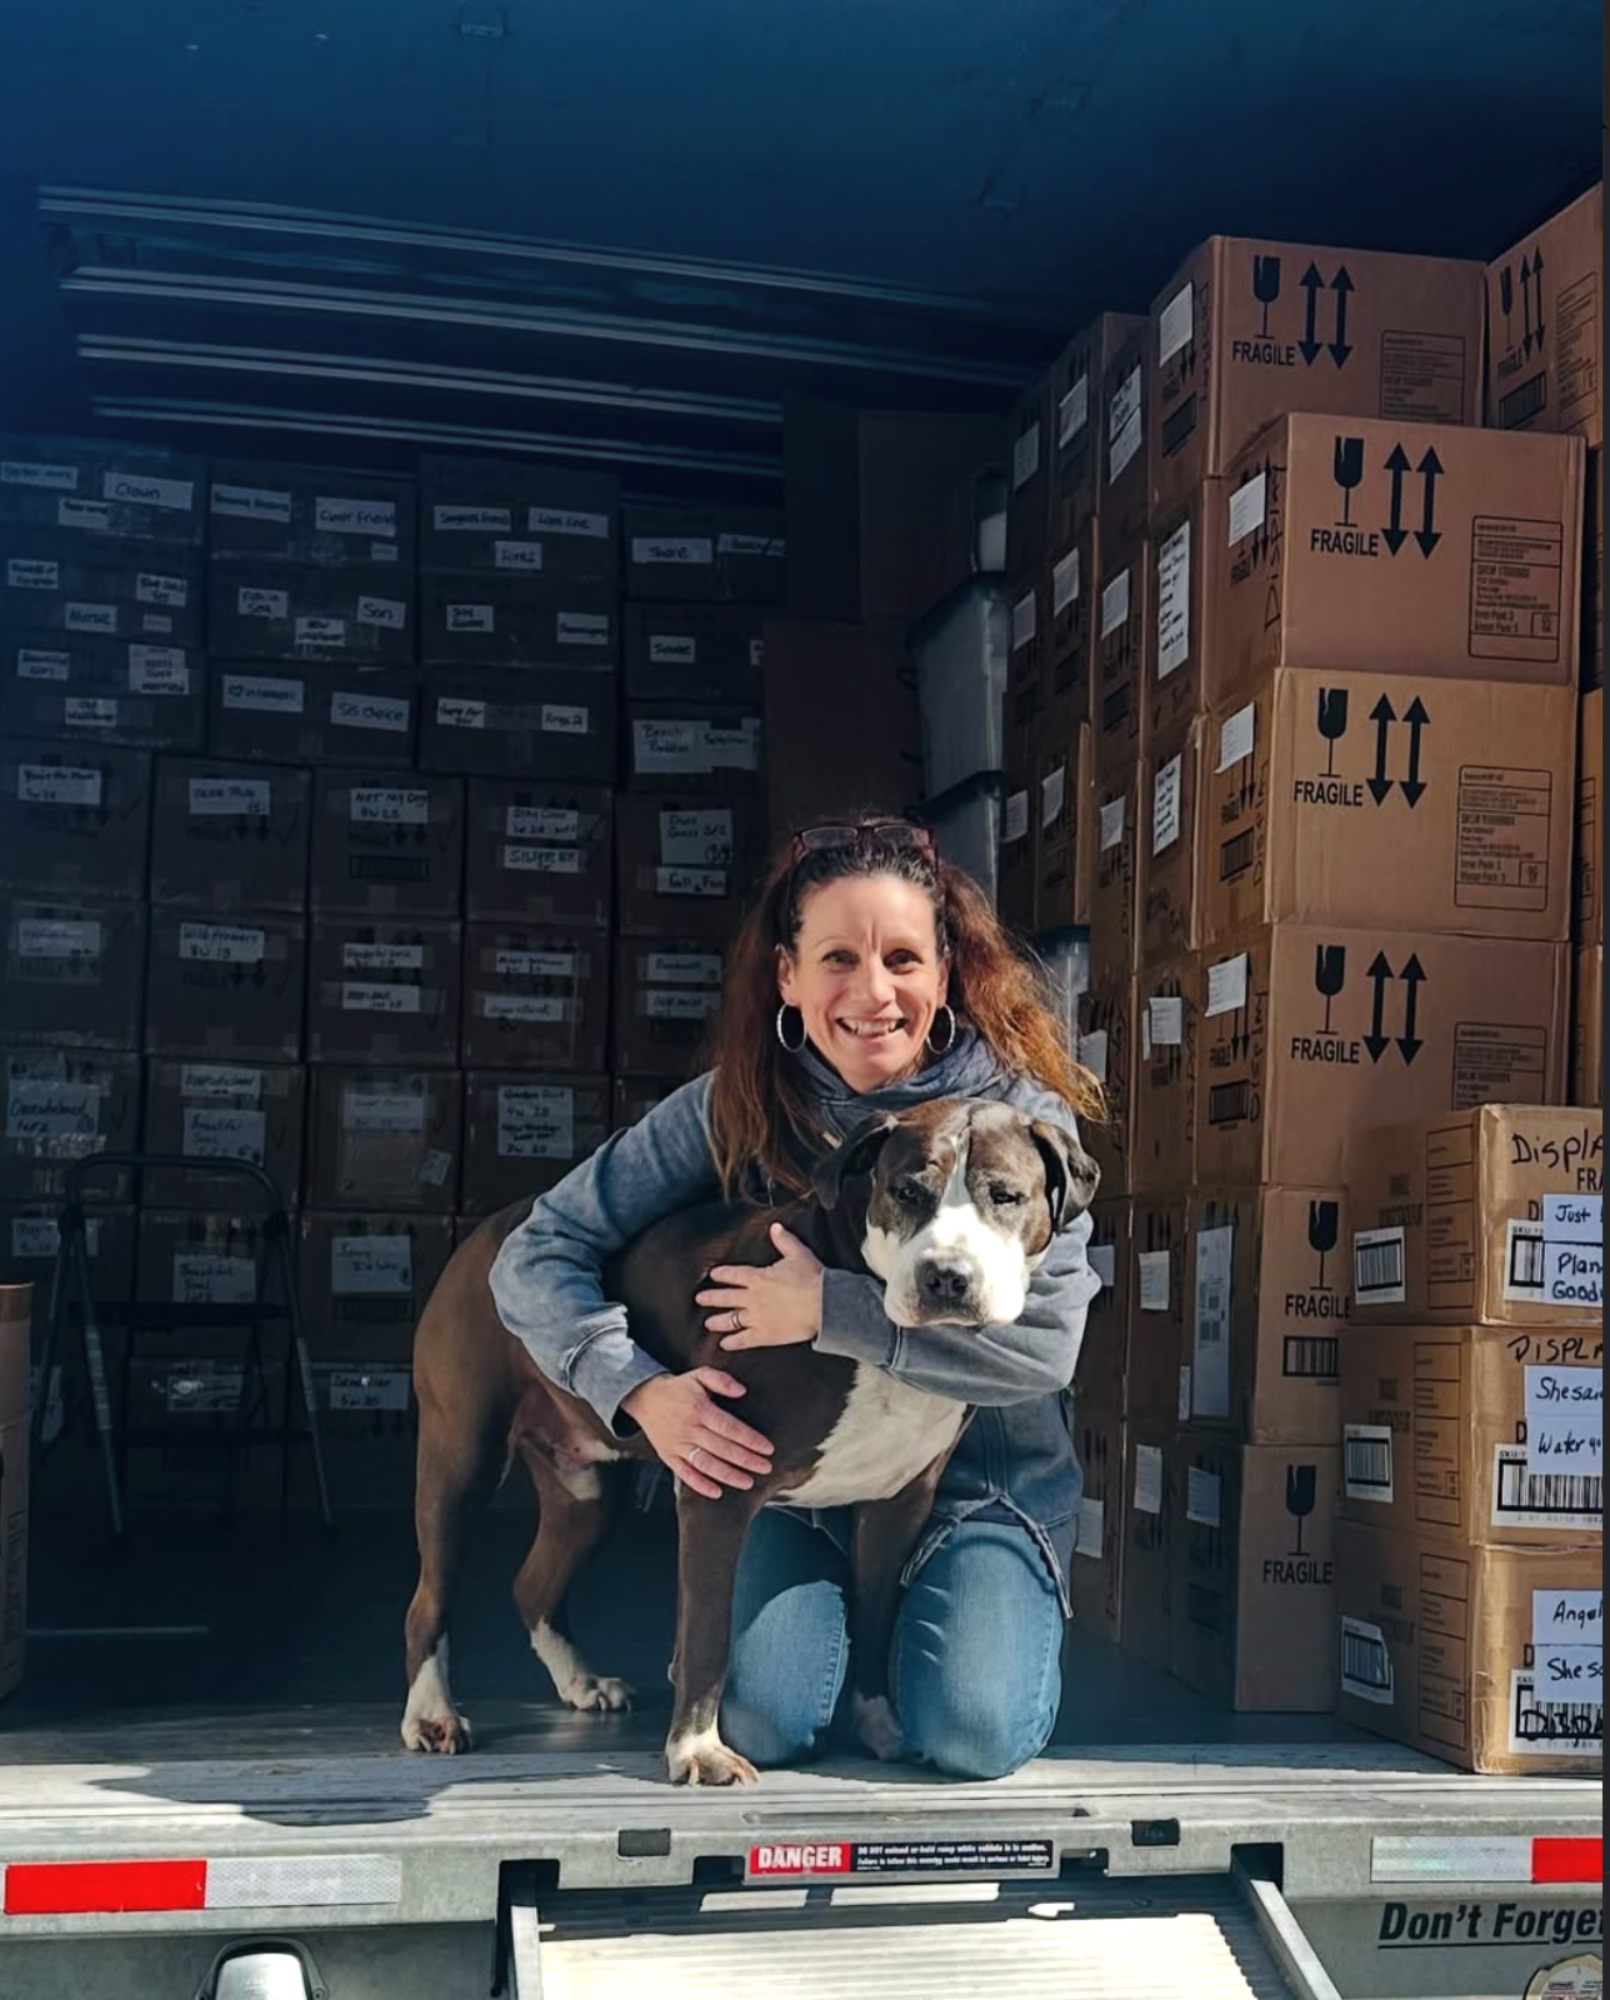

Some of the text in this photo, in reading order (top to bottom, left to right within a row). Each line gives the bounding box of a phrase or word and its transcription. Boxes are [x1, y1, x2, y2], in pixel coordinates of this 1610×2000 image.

[1233, 340, 1295, 366] FRAGILE
[1311, 529, 1379, 556] FRAGILE
[363, 602, 394, 621] Son
[1294, 780, 1363, 806] FRAGILE
[1291, 1037, 1360, 1064] FRAGILE
[1577, 1168, 1603, 1192] FR
[1555, 1204, 1592, 1224] Just
[1552, 1280, 1603, 1301] Good
[1285, 1294, 1351, 1319] FRAGILE
[1538, 1431, 1585, 1456] Water
[1263, 1561, 1333, 1584] FRAGILE
[1547, 1657, 1582, 1681] She
[758, 1846, 841, 1868] DANGER
[1378, 1902, 1603, 1944] Don't Forge
